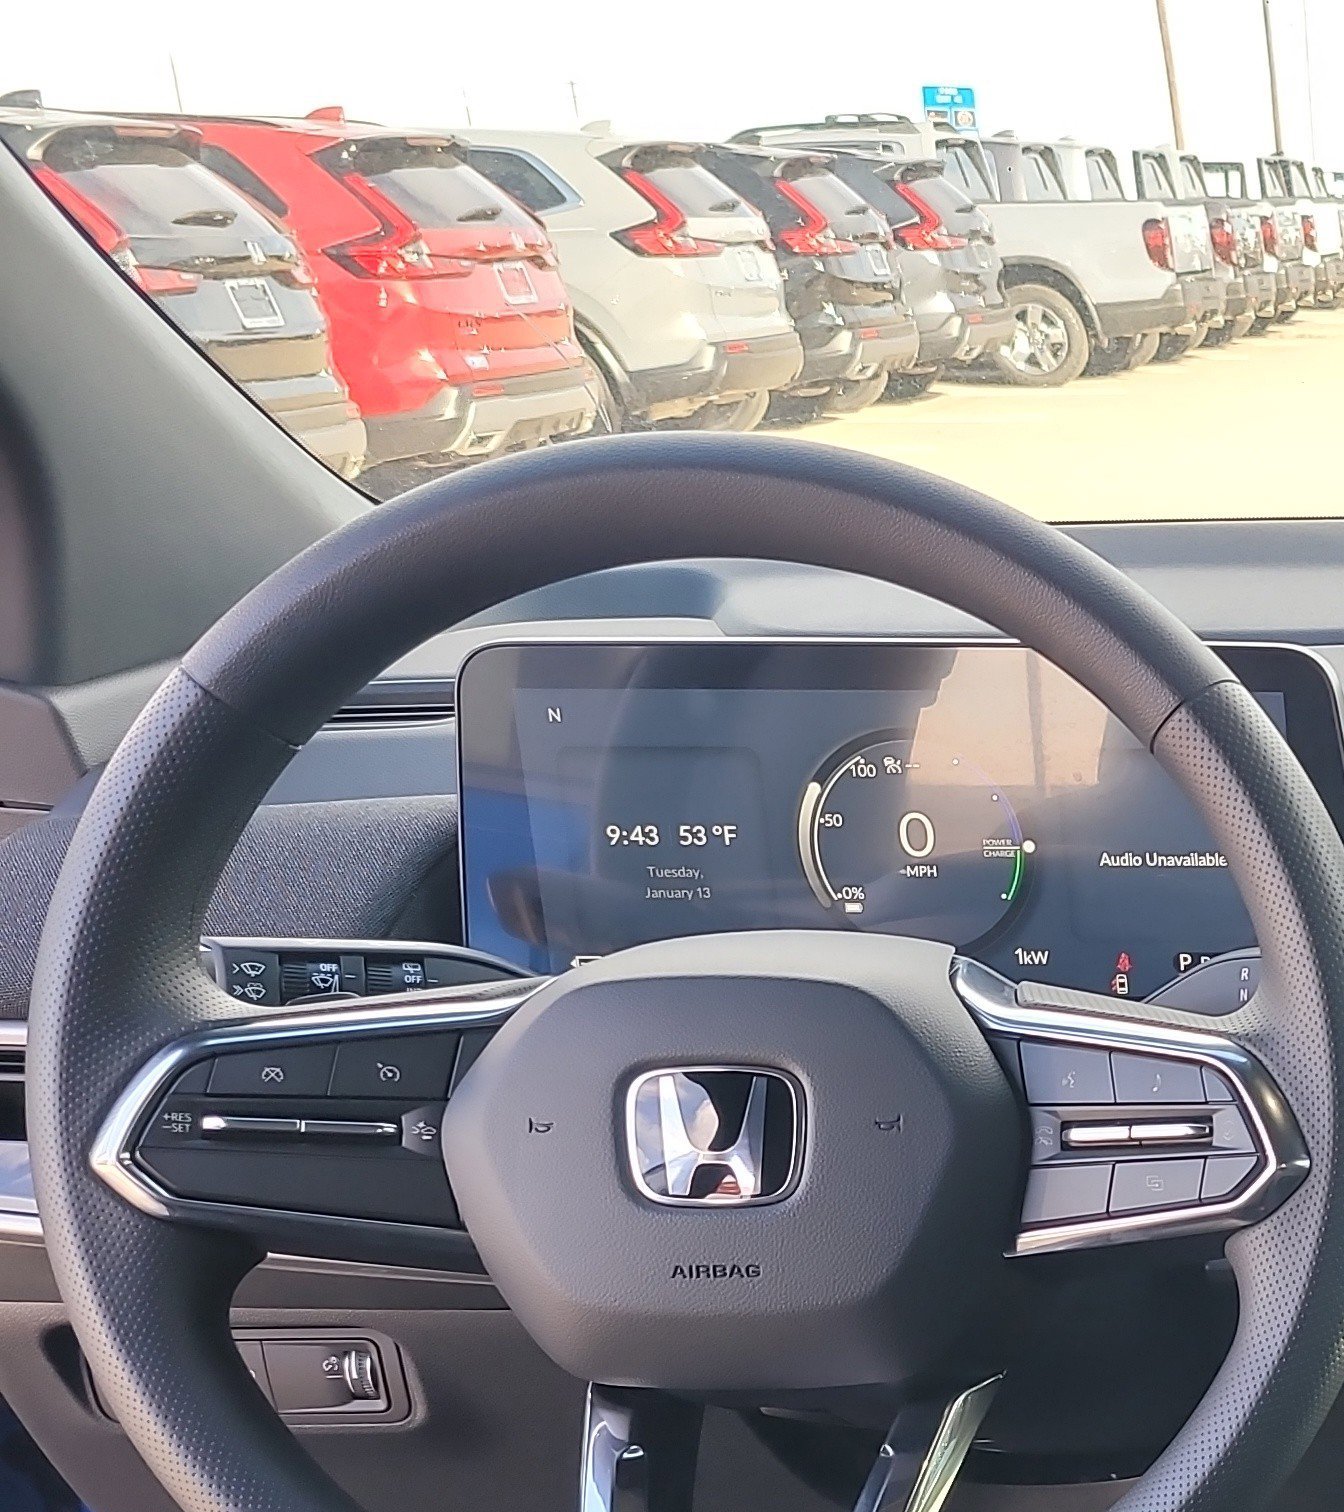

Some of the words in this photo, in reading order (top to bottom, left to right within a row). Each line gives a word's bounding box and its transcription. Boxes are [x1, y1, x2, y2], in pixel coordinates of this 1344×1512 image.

[547, 707, 562, 723] N
[851, 764, 877, 778] 100
[824, 813, 843, 827] 50
[606, 825, 660, 846] 9:43
[679, 825, 708, 846] 53
[712, 825, 737, 846] °F
[898, 812, 935, 858] 0
[983, 850, 1016, 858] CHARGE
[1099, 852, 1142, 867] Audio
[1146, 852, 1228, 867] Unavailable
[646, 866, 704, 879] Tuesday,
[906, 865, 938, 878] MPH
[645, 887, 693, 900] January
[697, 887, 711, 898] 13
[842, 886, 865, 900] 0%
[1014, 948, 1049, 965] 1kW
[1179, 953, 1192, 971] P
[320, 963, 338, 972] OFF
[1240, 967, 1249, 981] R
[404, 974, 422, 984] OFF
[1239, 988, 1248, 1001] N
[671, 1264, 761, 1279] AIRBAG
